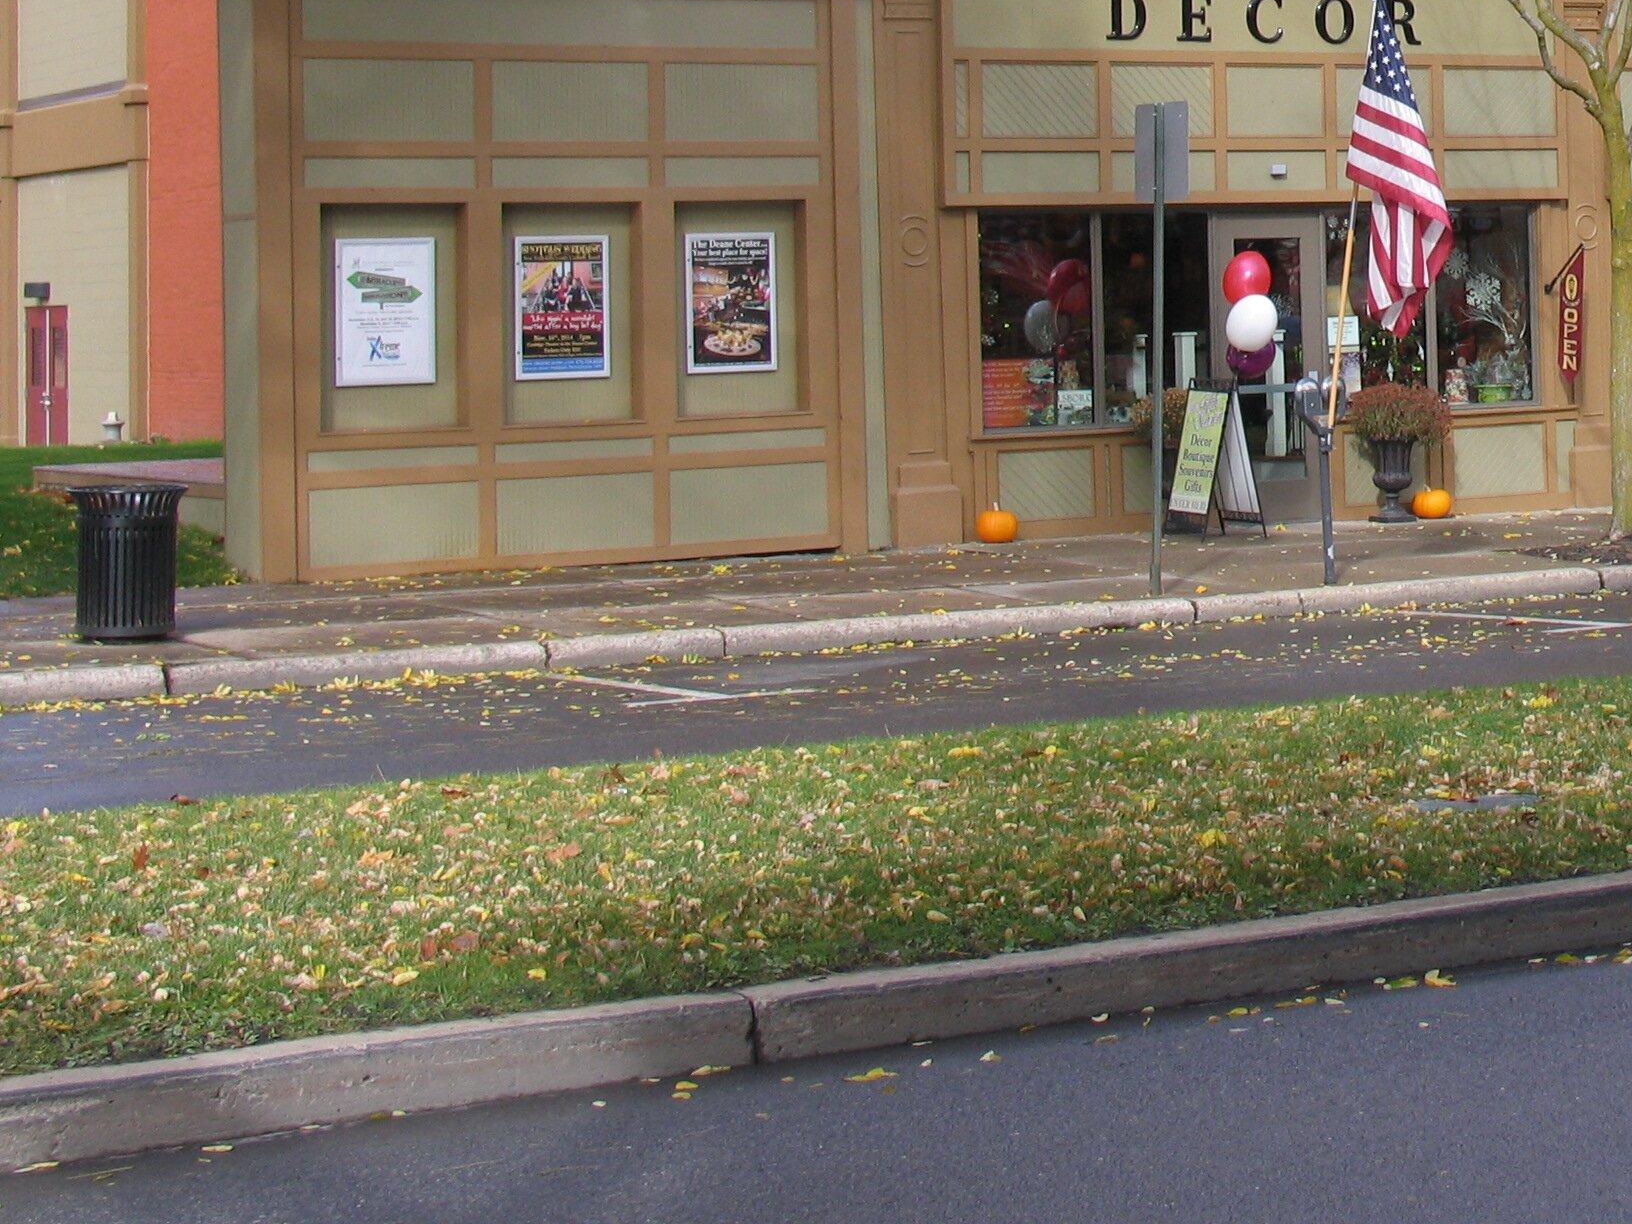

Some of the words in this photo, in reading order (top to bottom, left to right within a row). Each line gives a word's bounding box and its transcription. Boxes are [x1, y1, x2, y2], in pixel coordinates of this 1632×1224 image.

[1562, 307, 1579, 372] OPEN
[1190, 434, 1212, 448] Décor
[1183, 449, 1214, 466] Boutique
[1180, 463, 1214, 478] Souvenirs
[1184, 479, 1202, 492] Gifts
